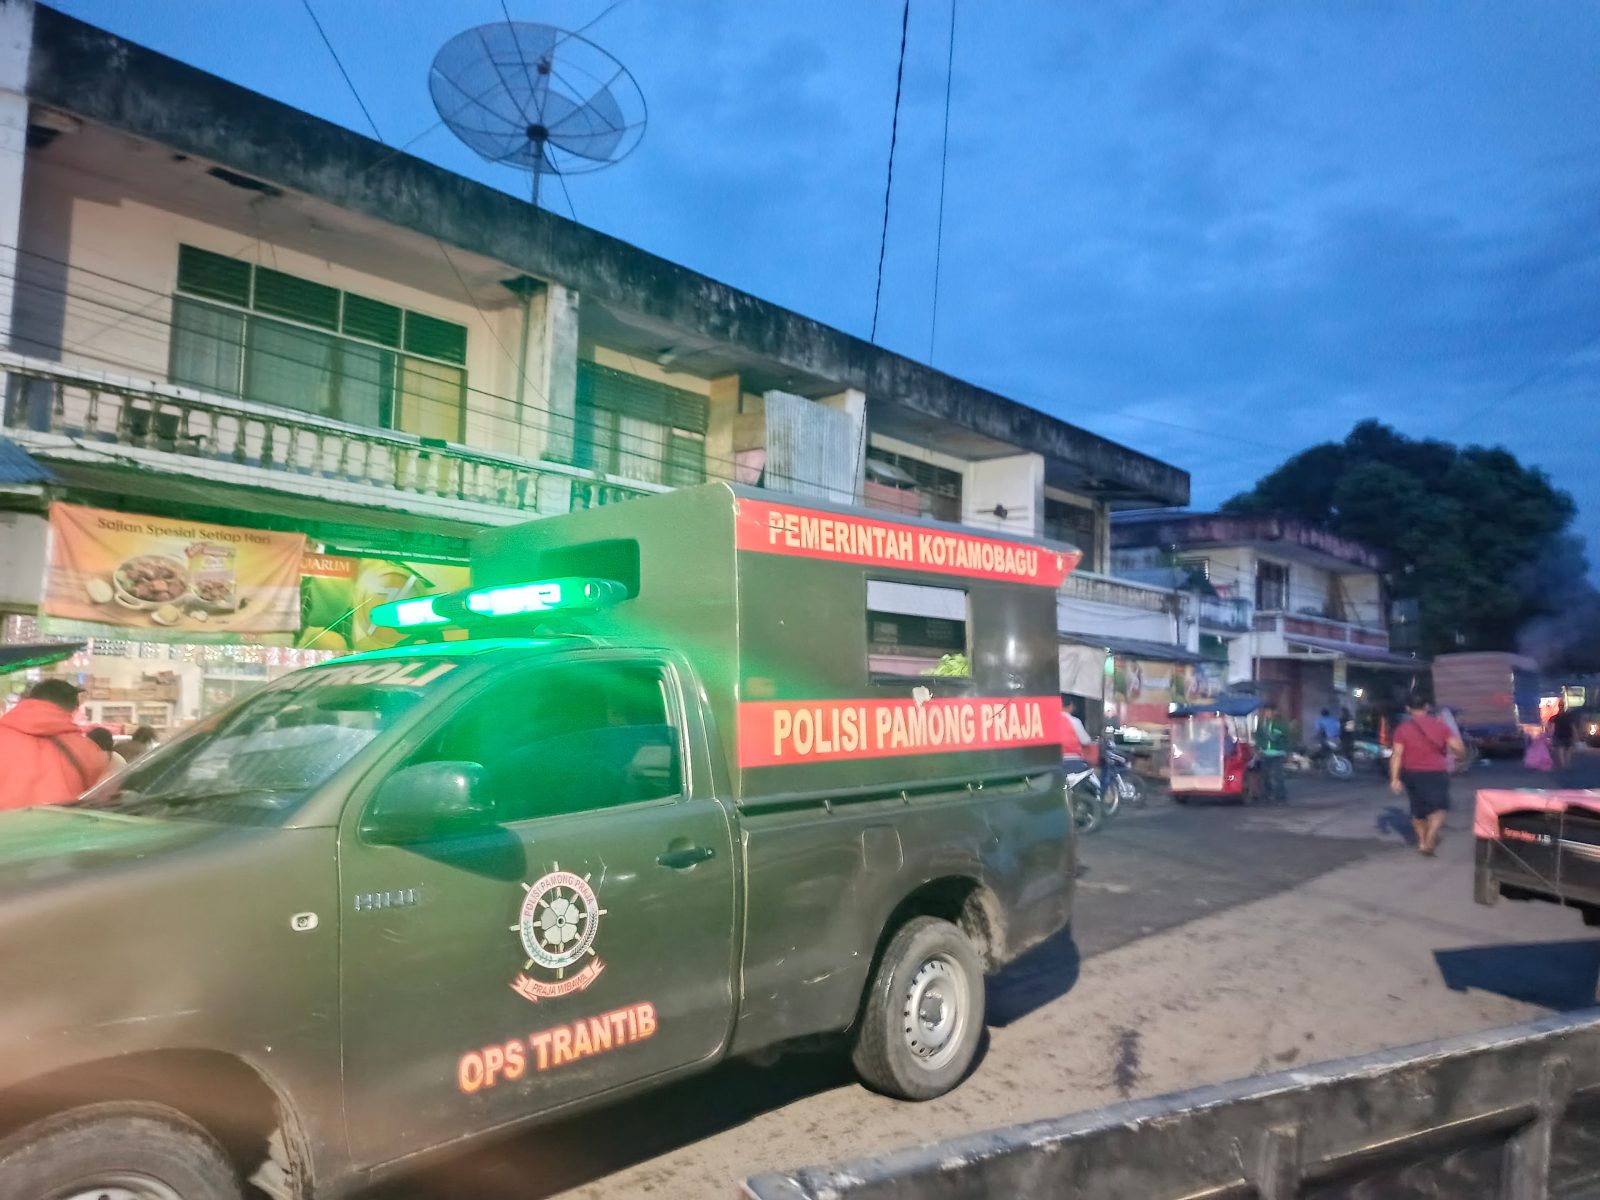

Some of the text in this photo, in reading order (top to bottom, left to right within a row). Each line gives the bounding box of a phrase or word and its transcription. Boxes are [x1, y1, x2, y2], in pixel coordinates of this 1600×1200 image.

[97, 517, 272, 545] Sajian Spesial Setiap Hari
[769, 511, 1038, 577] PEMERINTAH KOTAMOBAGU
[773, 702, 1043, 756] POLISI PAMONG PRAJA
[524, 875, 593, 917] POLISI PAMONG PRAJA
[532, 973, 588, 995] PRAJA WIBAWA
[459, 1002, 656, 1093] OPS TRANTIB
